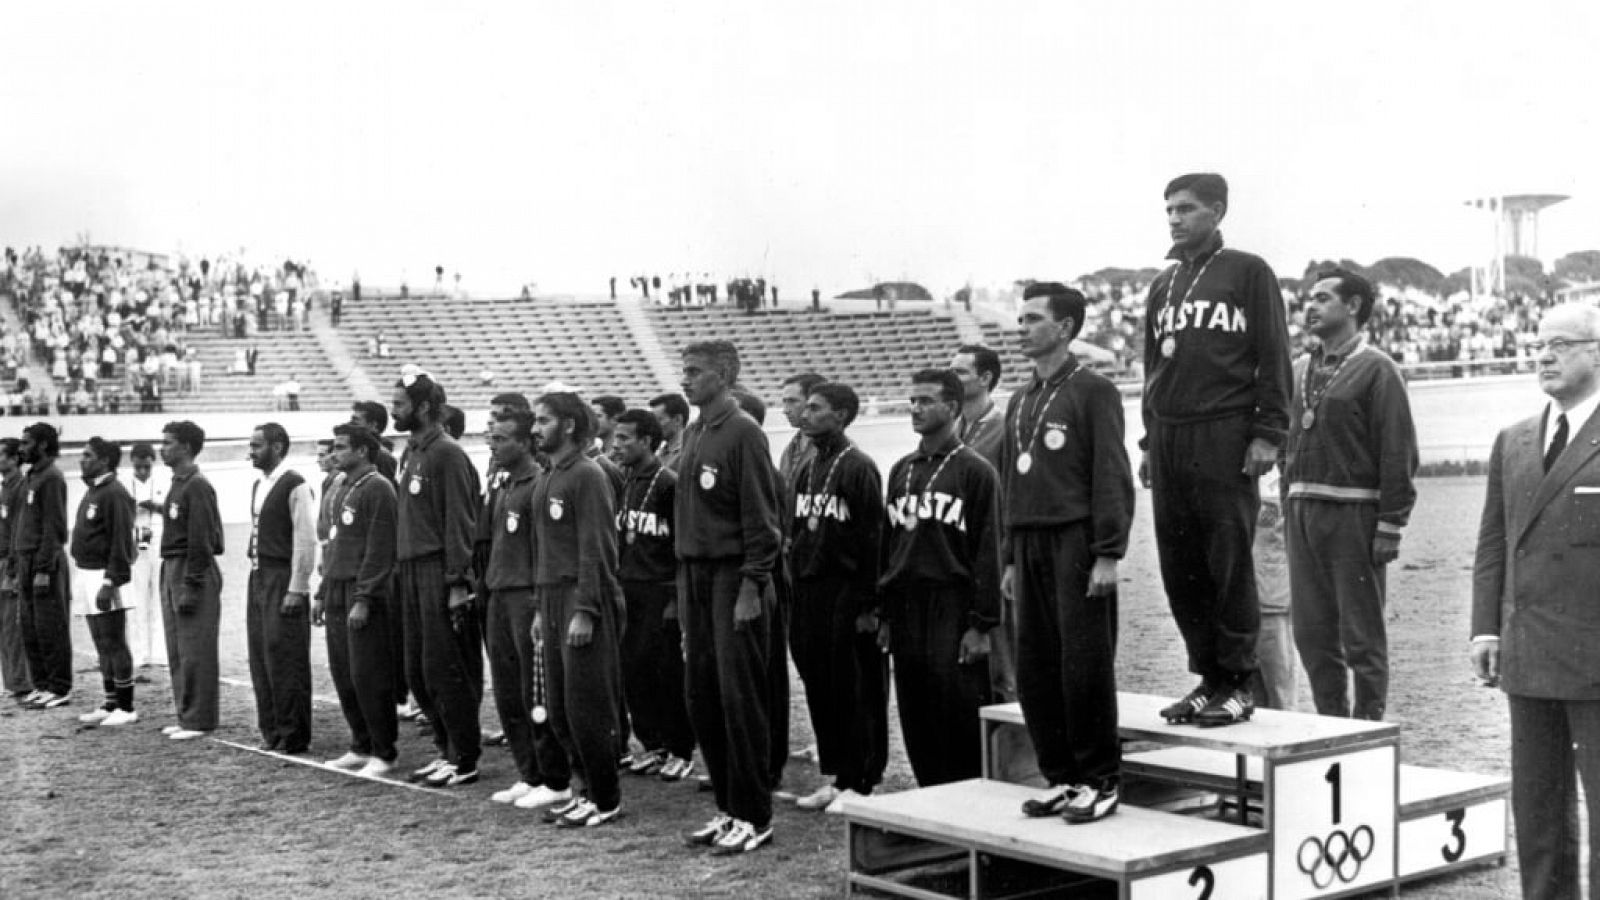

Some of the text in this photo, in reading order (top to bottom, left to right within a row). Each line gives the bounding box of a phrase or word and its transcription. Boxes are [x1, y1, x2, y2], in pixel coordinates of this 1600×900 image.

[1325, 762, 1341, 825] 1
[1441, 808, 1466, 862] 3
[1188, 865, 1215, 900] 2
